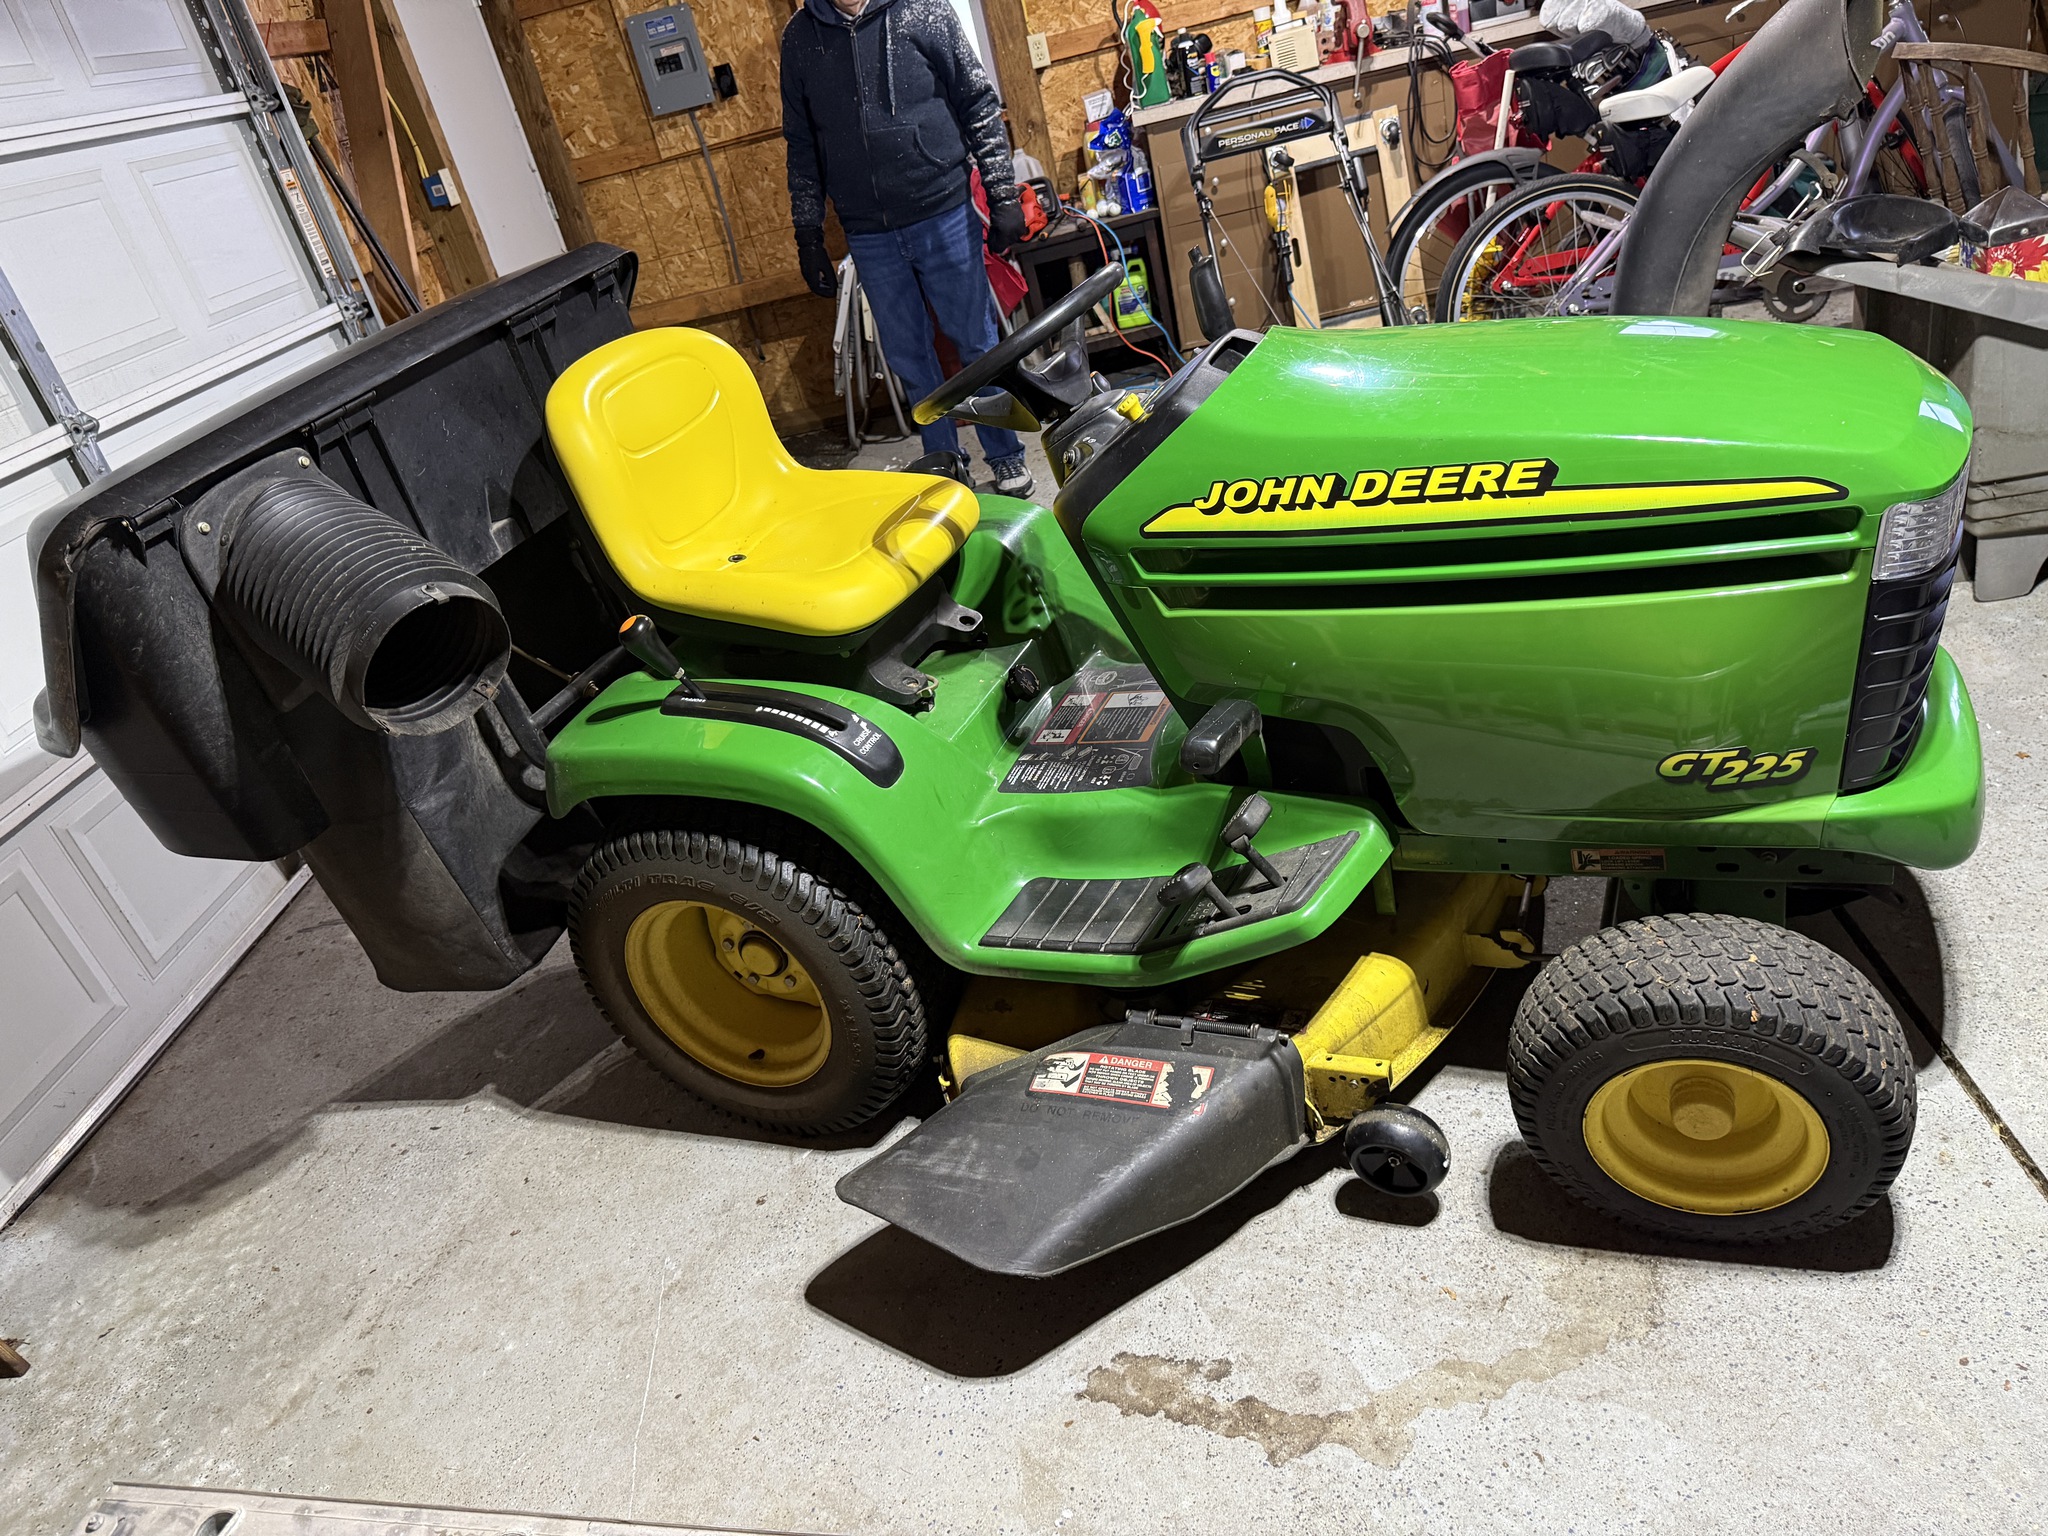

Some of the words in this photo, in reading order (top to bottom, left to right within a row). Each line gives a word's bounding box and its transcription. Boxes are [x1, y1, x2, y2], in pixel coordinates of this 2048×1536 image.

[1218, 130, 1271, 148] PERSONAL
[1273, 122, 1300, 135] PACE
[1194, 472, 1342, 512] JOHN
[1350, 459, 1550, 503] DEERE
[852, 726, 872, 747] CRUISE
[859, 732, 882, 756] CONTROL
[647, 873, 717, 892] TRAC
[1109, 1056, 1153, 1070] DANGER
[1020, 1102, 1039, 1113] DO
[1046, 1105, 1073, 1118] NOT
